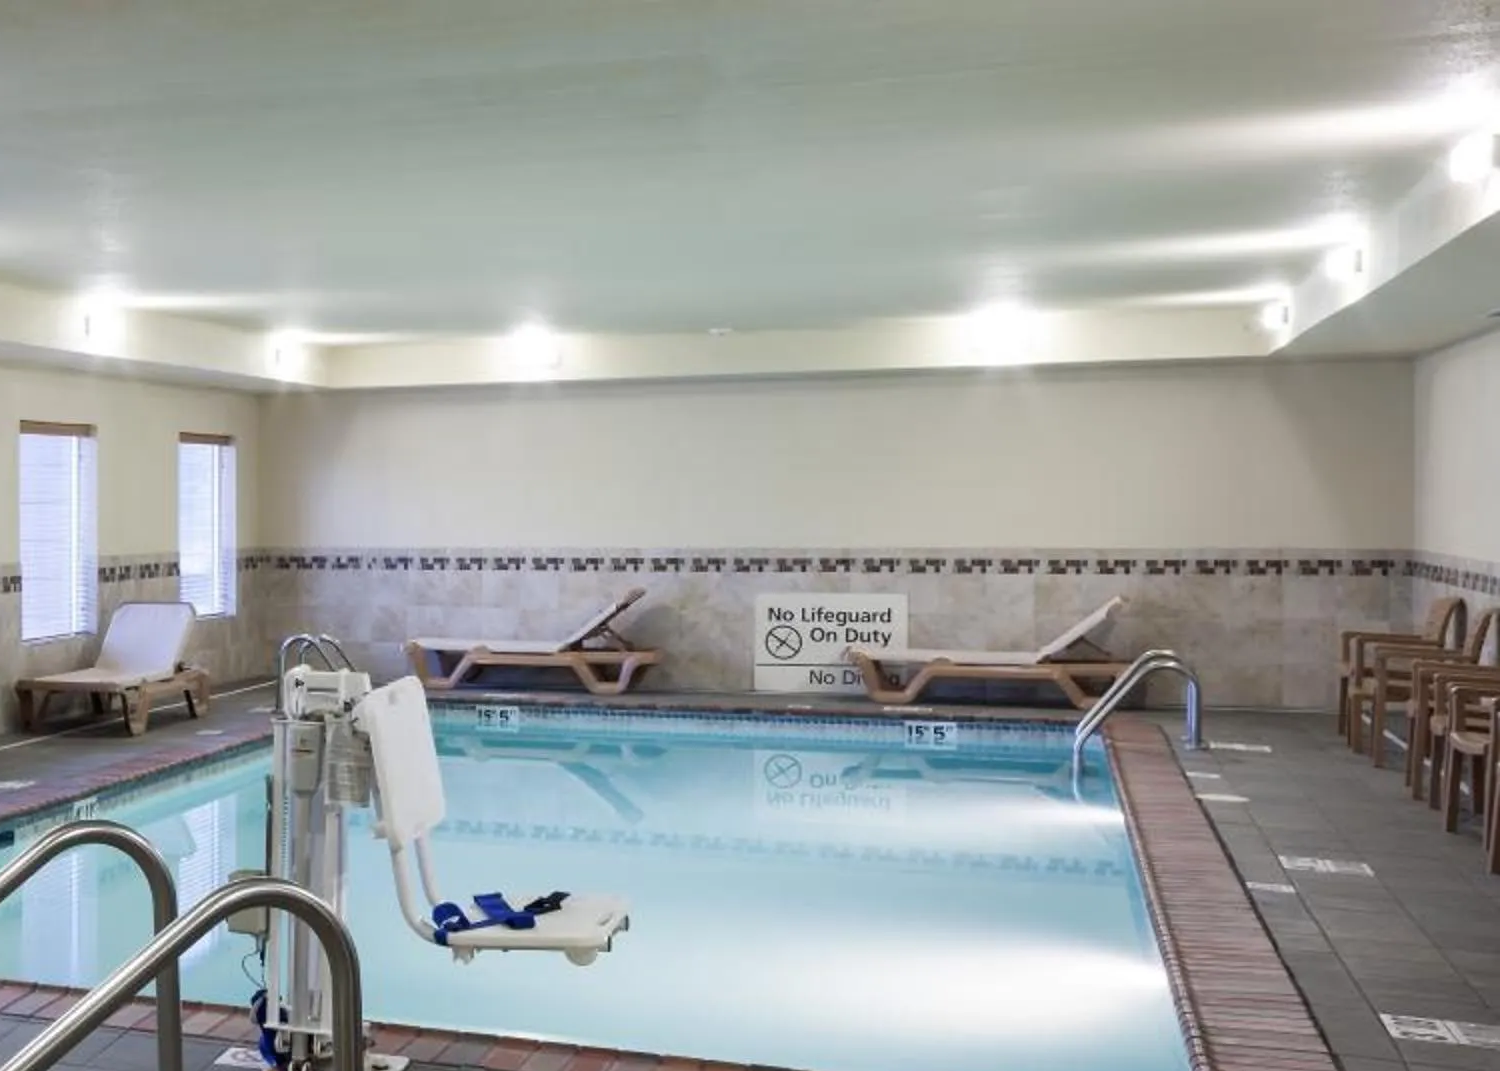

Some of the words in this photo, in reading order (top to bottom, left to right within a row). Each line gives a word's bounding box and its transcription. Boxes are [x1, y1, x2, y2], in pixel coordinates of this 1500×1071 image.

[767, 607, 795, 622] No
[801, 606, 892, 626] Lifeguard
[809, 627, 837, 643] On
[845, 627, 892, 647] Duty
[809, 669, 836, 685] No
